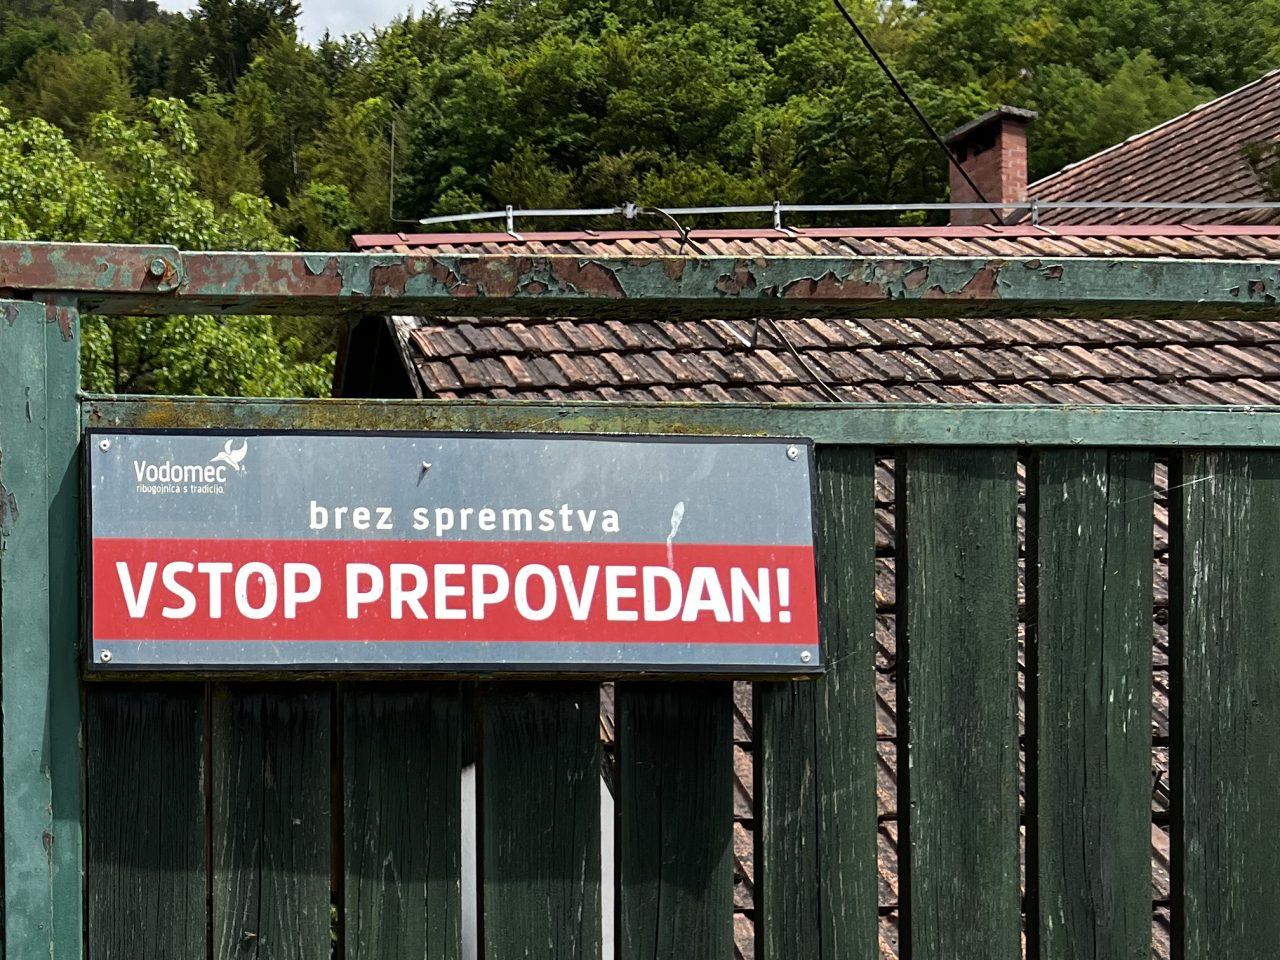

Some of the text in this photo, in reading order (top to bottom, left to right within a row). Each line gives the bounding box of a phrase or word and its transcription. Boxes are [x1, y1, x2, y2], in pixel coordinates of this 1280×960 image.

[133, 460, 227, 483] Vodomec
[136, 483, 180, 495] ribogojnica
[190, 483, 224, 495] tradicijo
[309, 501, 620, 537] brez spremstva
[116, 560, 792, 624] VSTOP PREPOVEDAN!
